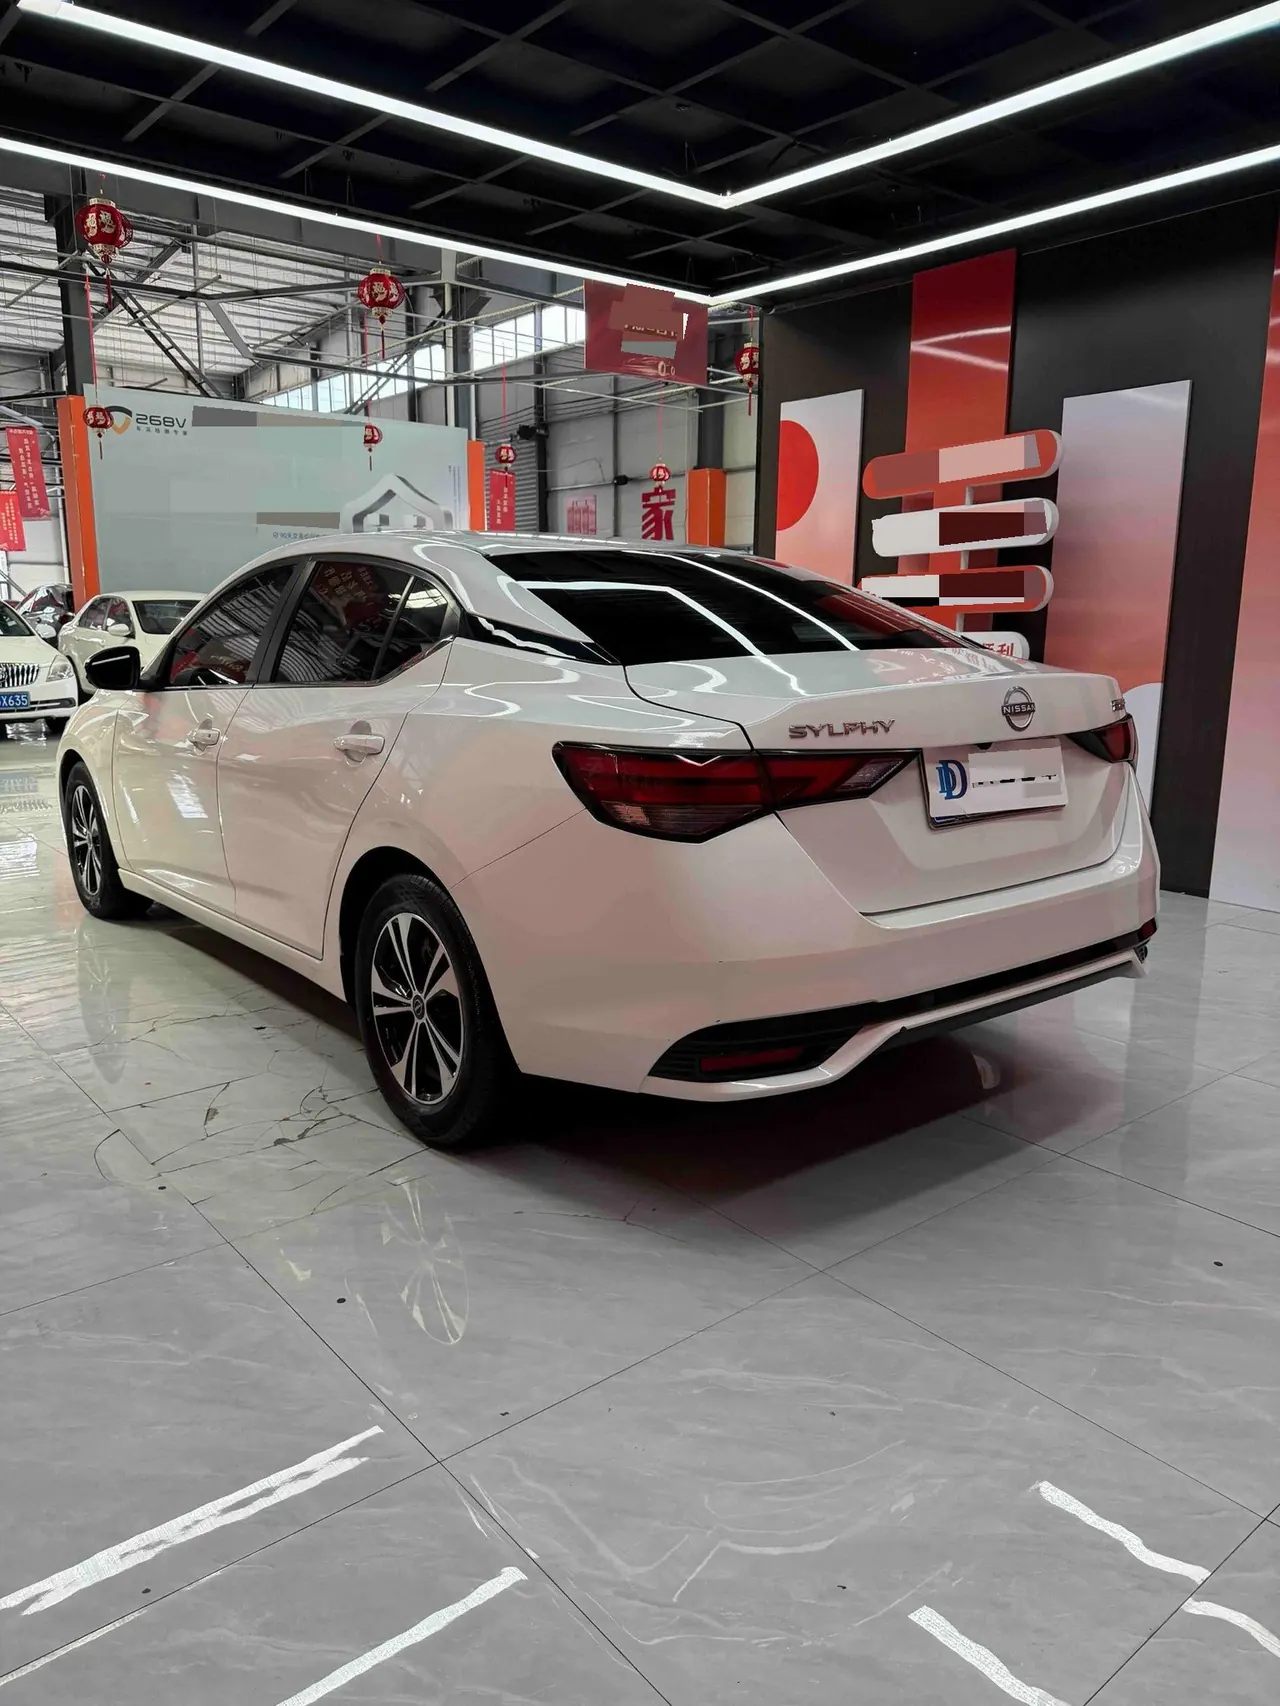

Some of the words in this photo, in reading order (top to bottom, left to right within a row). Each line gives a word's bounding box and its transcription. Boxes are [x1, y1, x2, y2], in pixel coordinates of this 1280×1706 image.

[135, 412, 187, 429] 268V
[641, 485, 676, 541] 家
[0, 694, 28, 707] X635
[1003, 703, 1035, 713] NISSAN
[788, 718, 896, 739] SYLPHY
